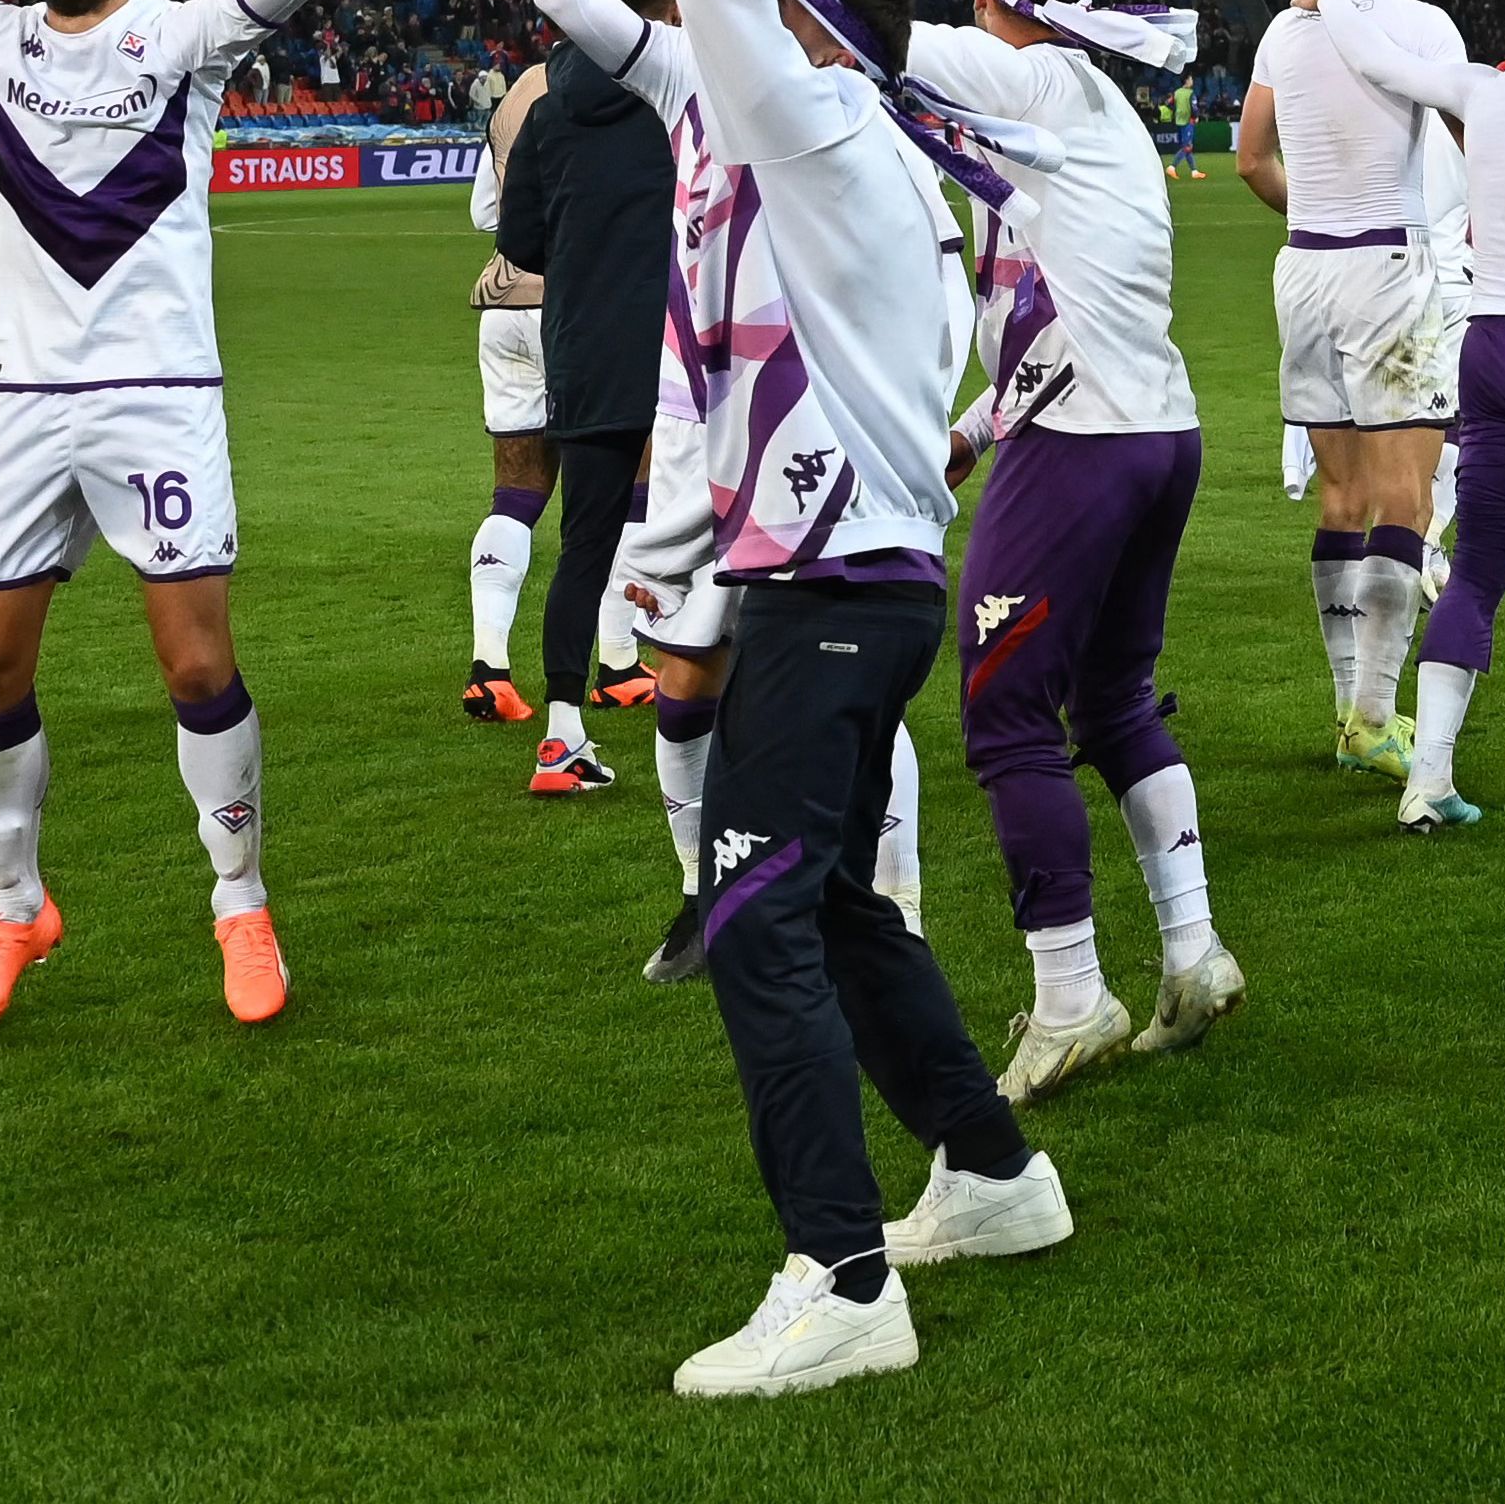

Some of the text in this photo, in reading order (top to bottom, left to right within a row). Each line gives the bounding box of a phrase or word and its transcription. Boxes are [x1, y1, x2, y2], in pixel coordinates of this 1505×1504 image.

[7, 76, 148, 119] Mediacom
[229, 154, 345, 184] STRAUSS
[128, 470, 194, 531] 16
